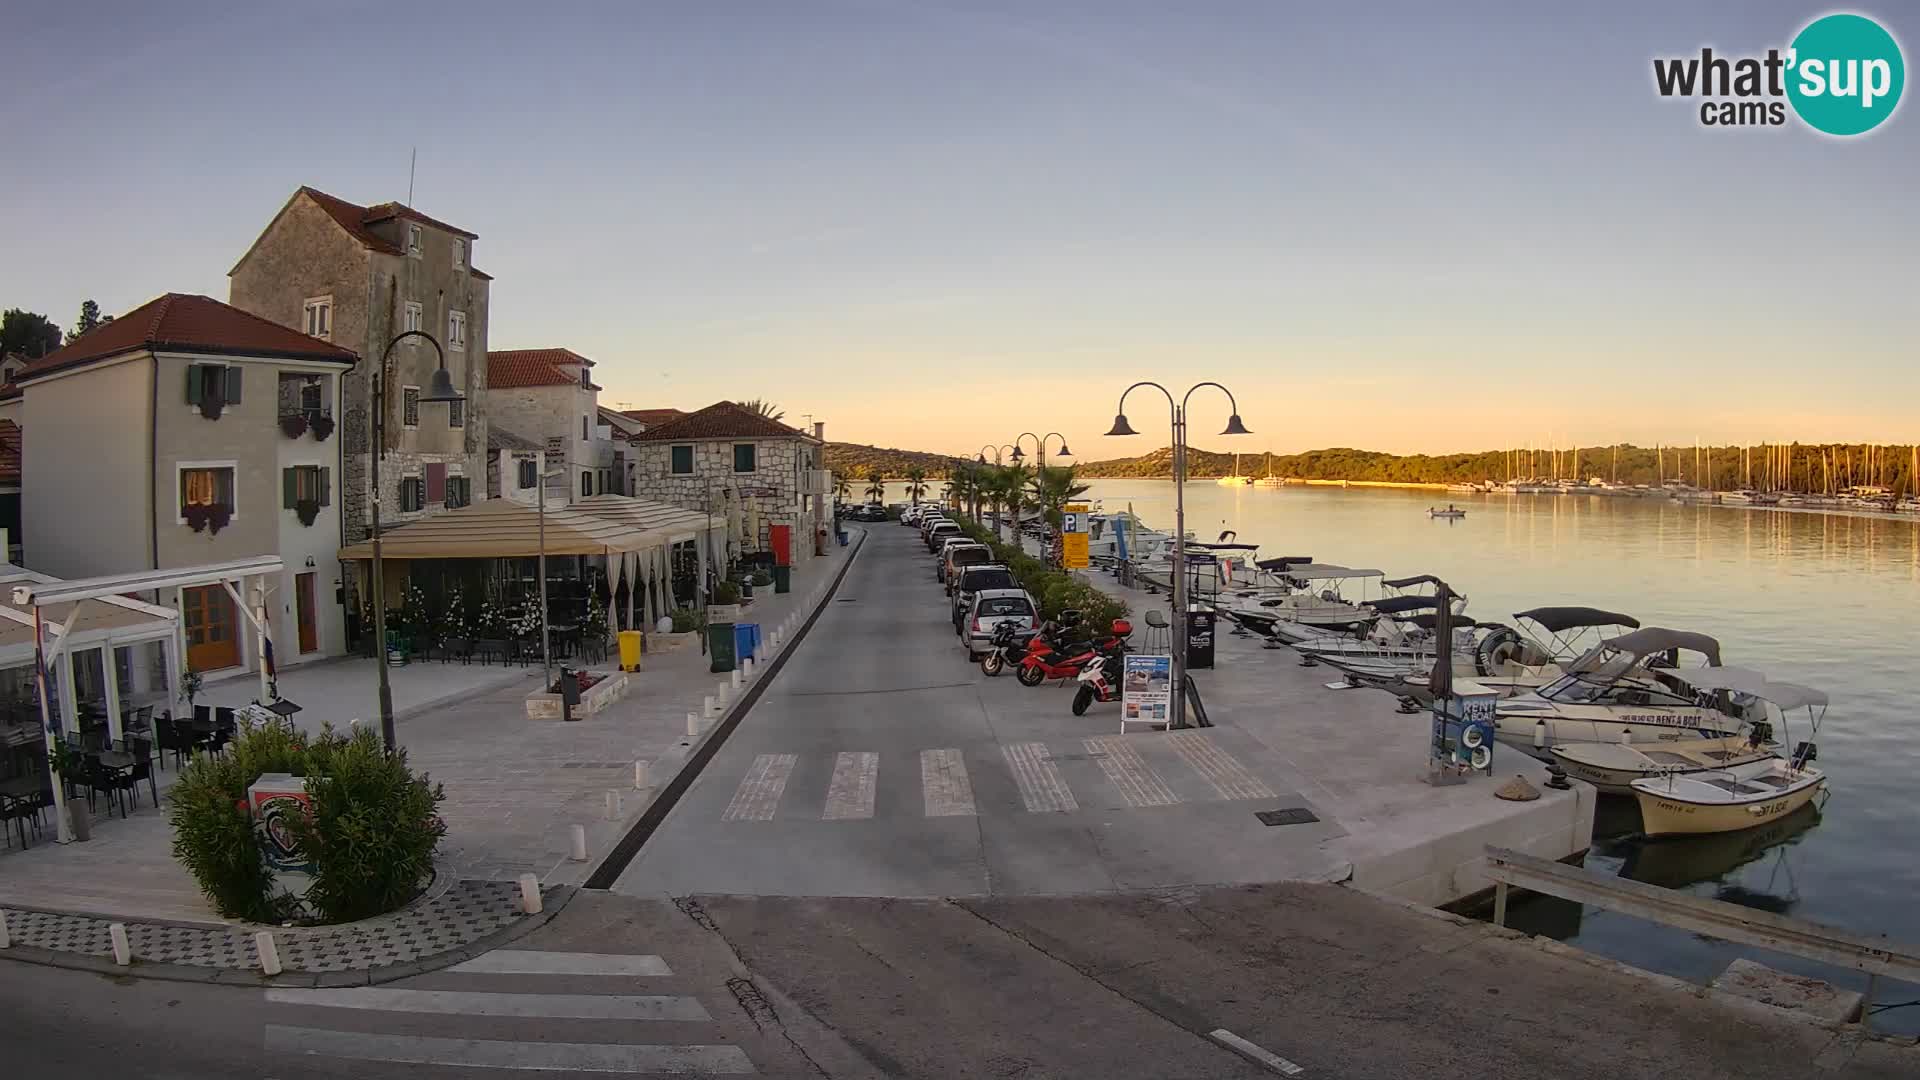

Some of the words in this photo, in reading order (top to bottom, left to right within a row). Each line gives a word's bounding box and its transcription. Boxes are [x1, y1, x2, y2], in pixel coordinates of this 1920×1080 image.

[1064, 514, 1076, 531] P
[1463, 702, 1496, 713] RENT
[1463, 712, 1470, 721] A
[1472, 712, 1495, 721] BOAT
[1656, 715, 1676, 725] RENT
[1682, 715, 1702, 727] BOAT
